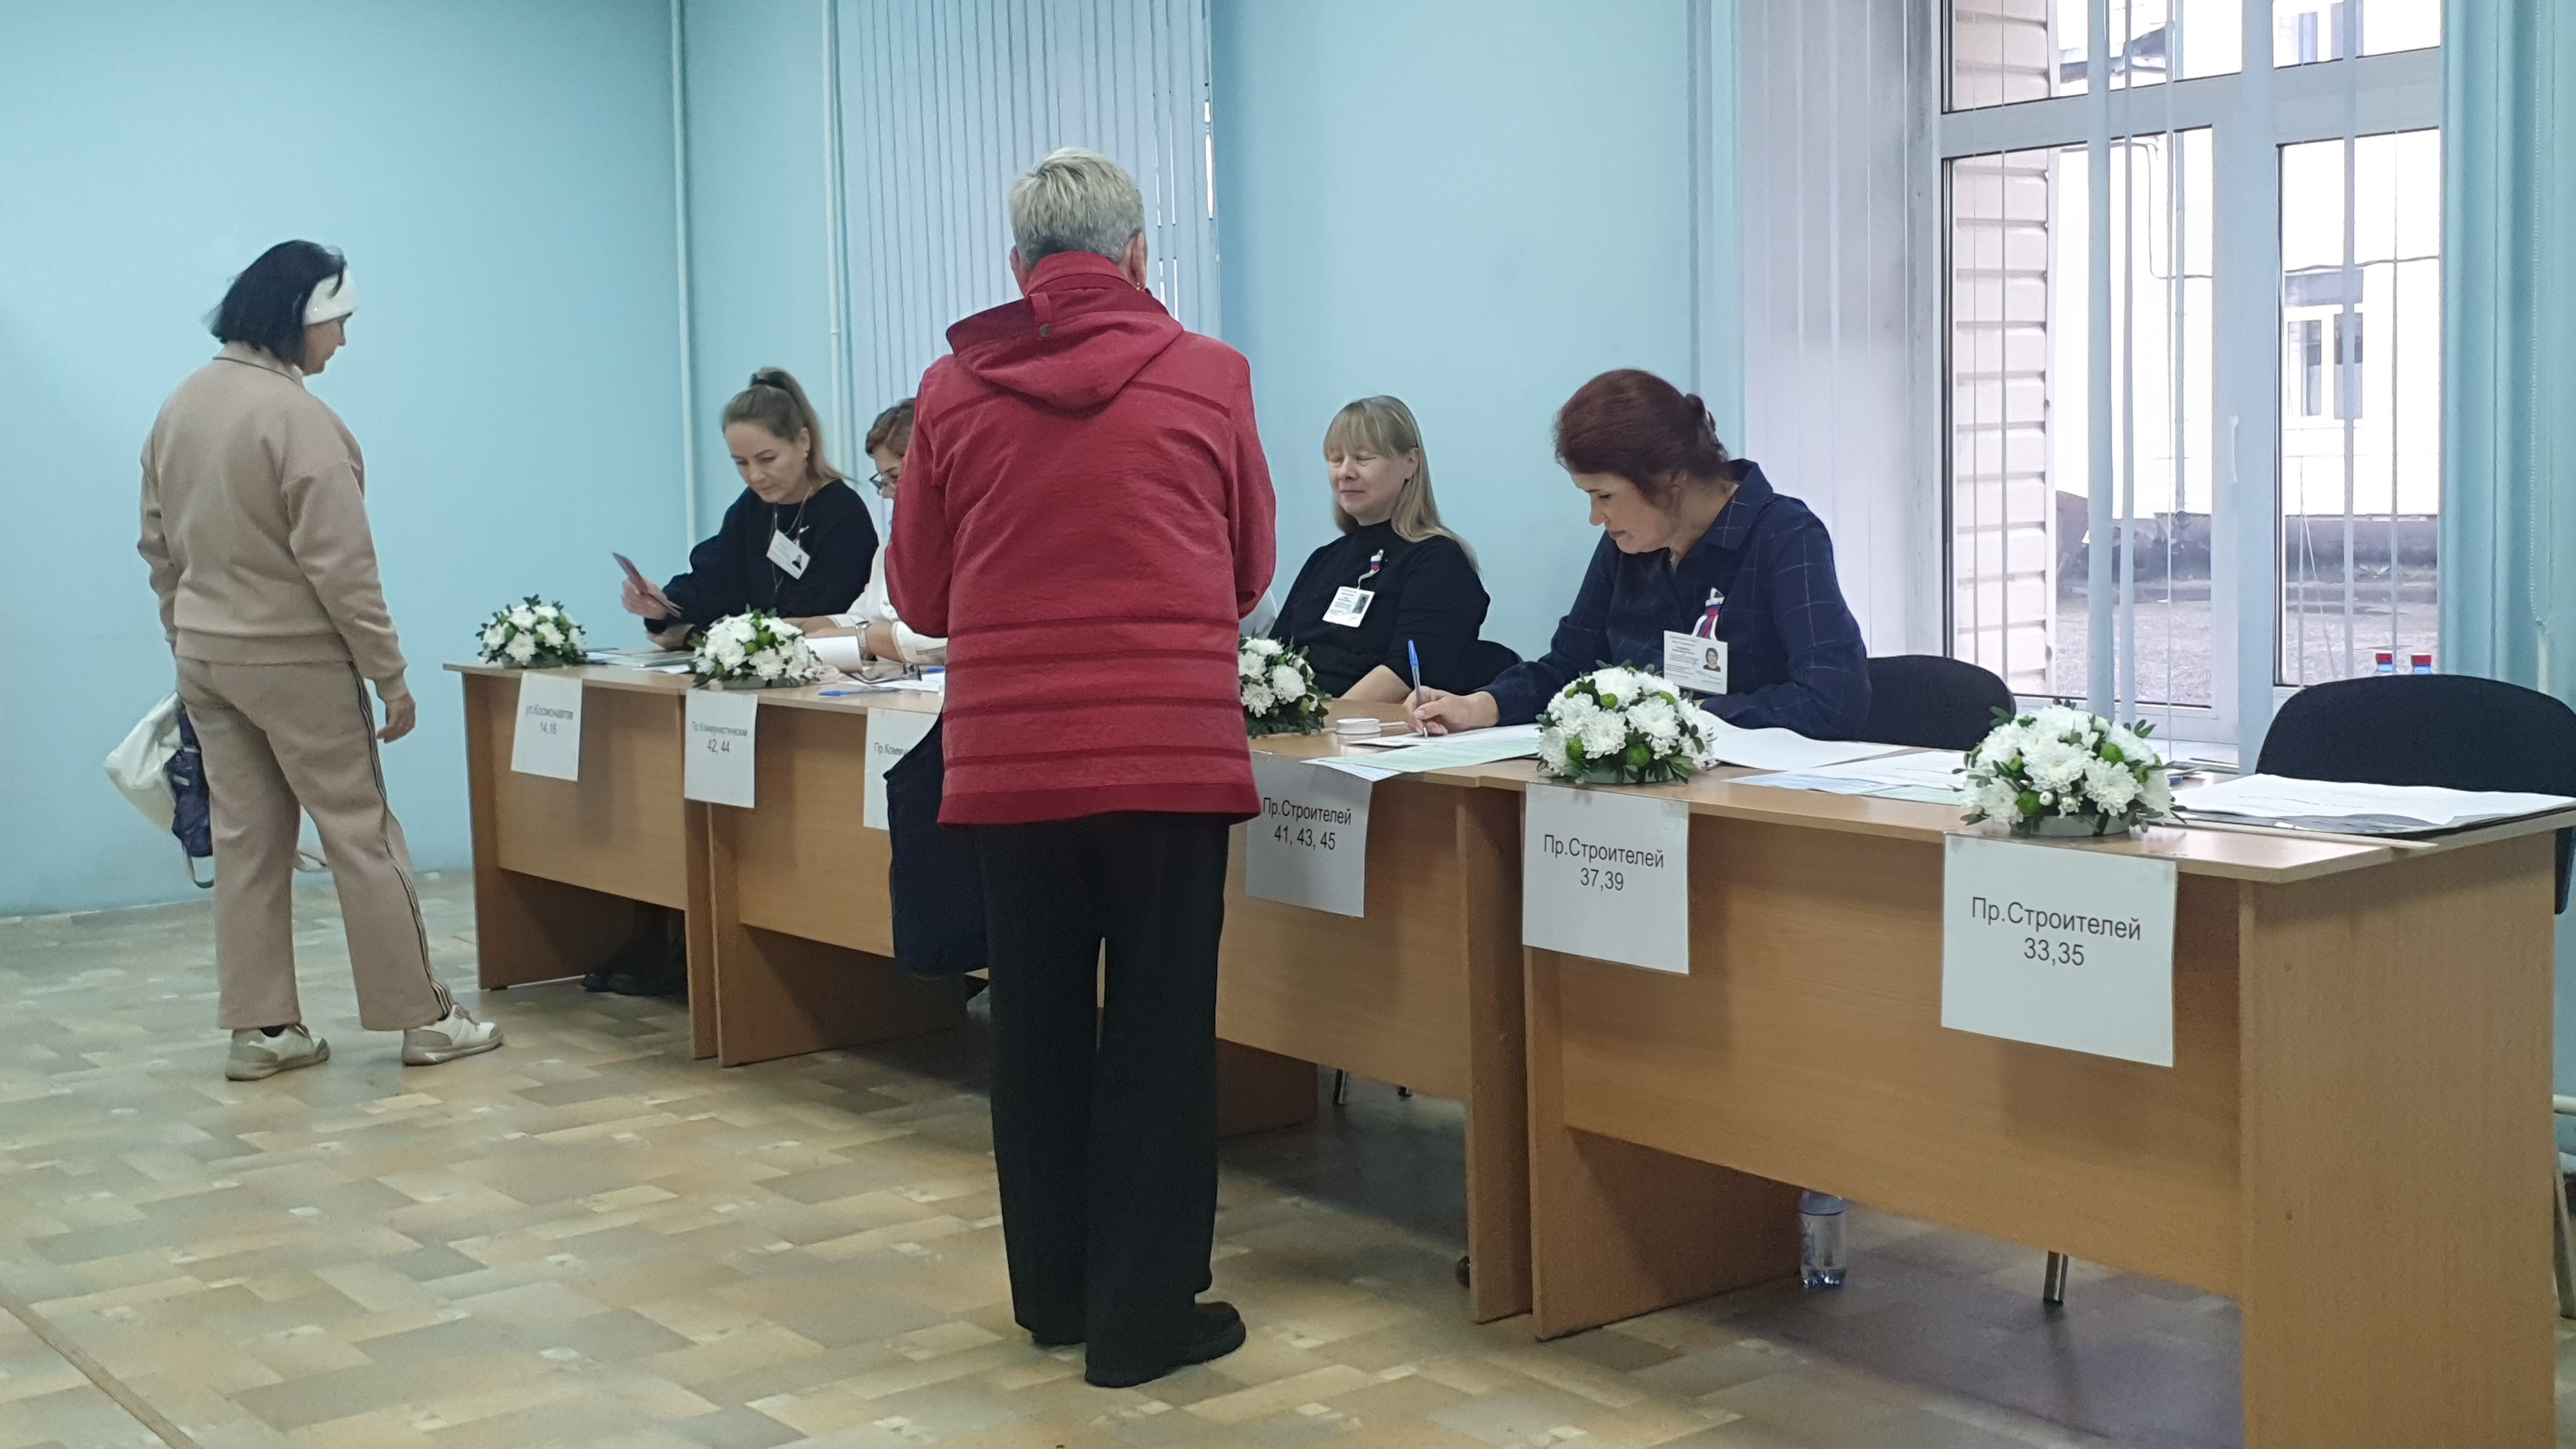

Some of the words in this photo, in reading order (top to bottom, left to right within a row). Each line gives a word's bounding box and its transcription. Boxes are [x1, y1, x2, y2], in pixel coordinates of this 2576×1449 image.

[1262, 797, 1352, 825] Пр.Строителей
[1274, 825, 1293, 847] 41,
[1296, 828, 1316, 850] 43,
[1320, 831, 1336, 850] 45
[1544, 834, 1664, 868] Пр.Строителей
[1580, 868, 1624, 891] 37,39
[1972, 896, 2141, 940] Пр.Строителей
[2023, 937, 2085, 966] 33,35
